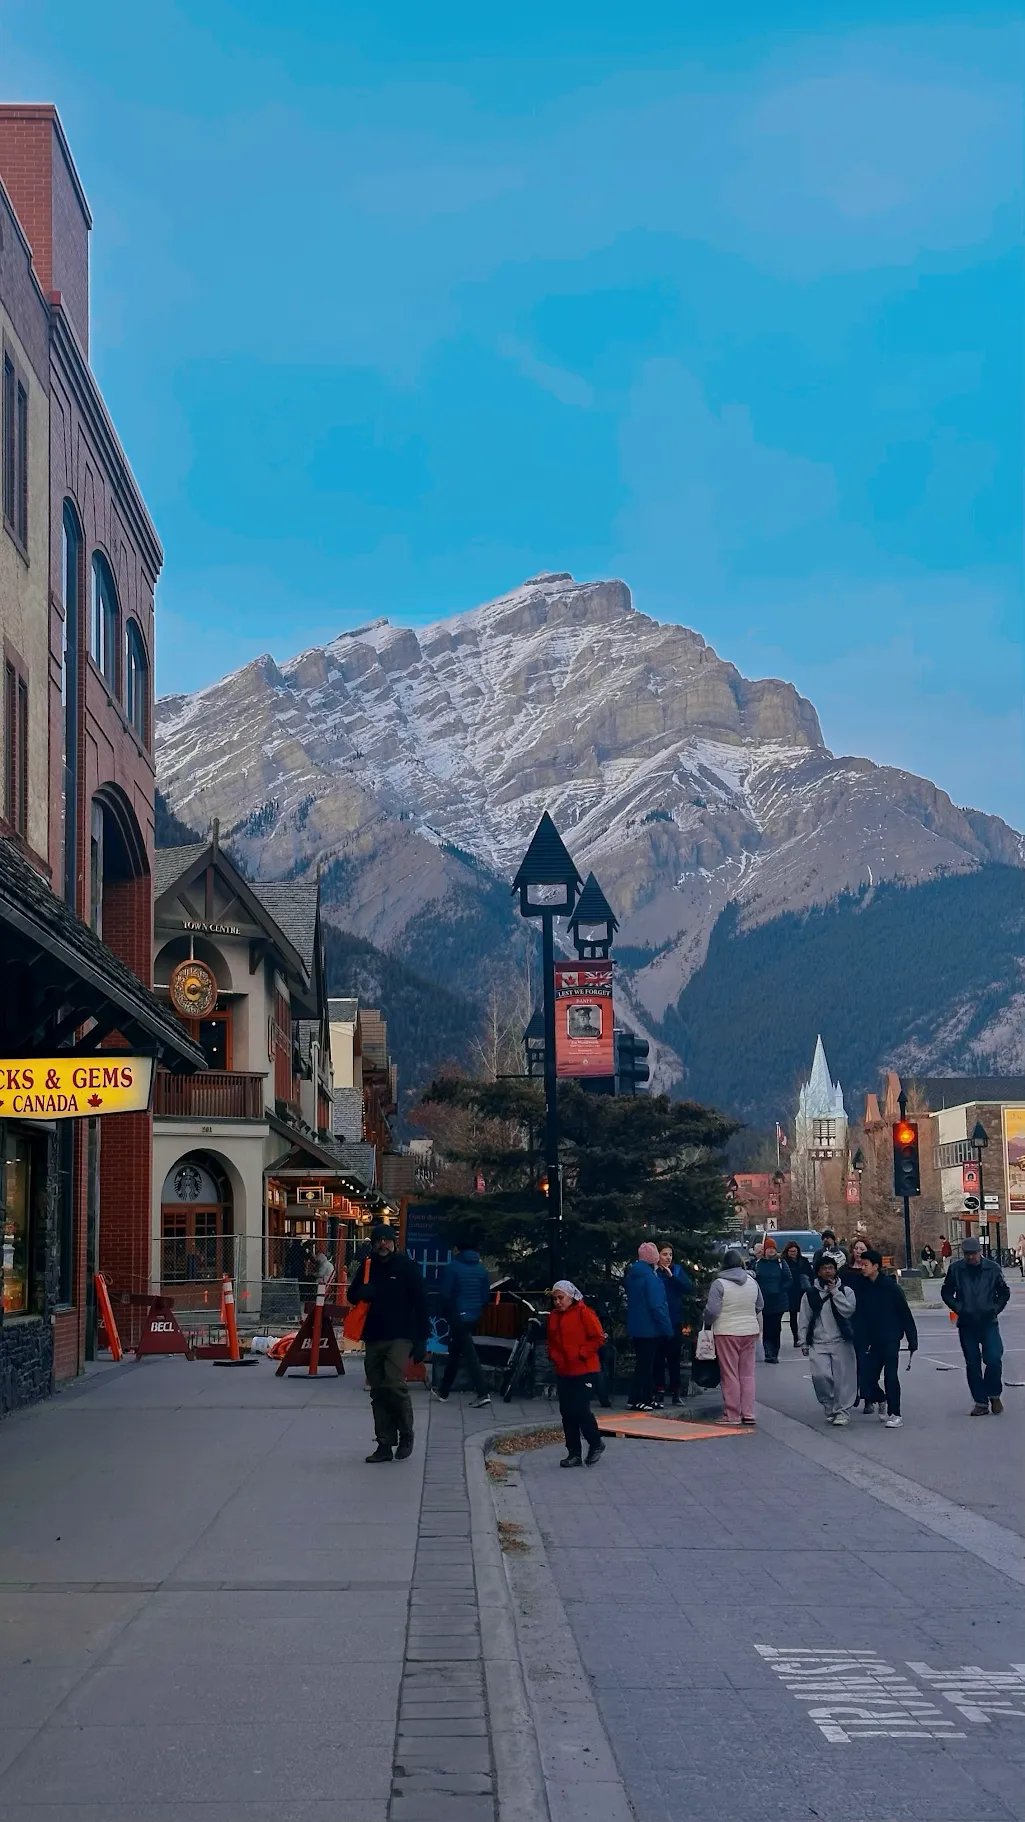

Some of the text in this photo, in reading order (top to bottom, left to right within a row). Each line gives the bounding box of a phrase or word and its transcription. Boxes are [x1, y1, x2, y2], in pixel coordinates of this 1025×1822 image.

[182, 920, 241, 935] TOWN CENTRE
[45, 1069, 61, 1089] &
[72, 1067, 133, 1089] GEMS
[13, 1094, 79, 1112] CANADA
[151, 1321, 175, 1332] BECL
[753, 1644, 967, 1743] TRANSIT
